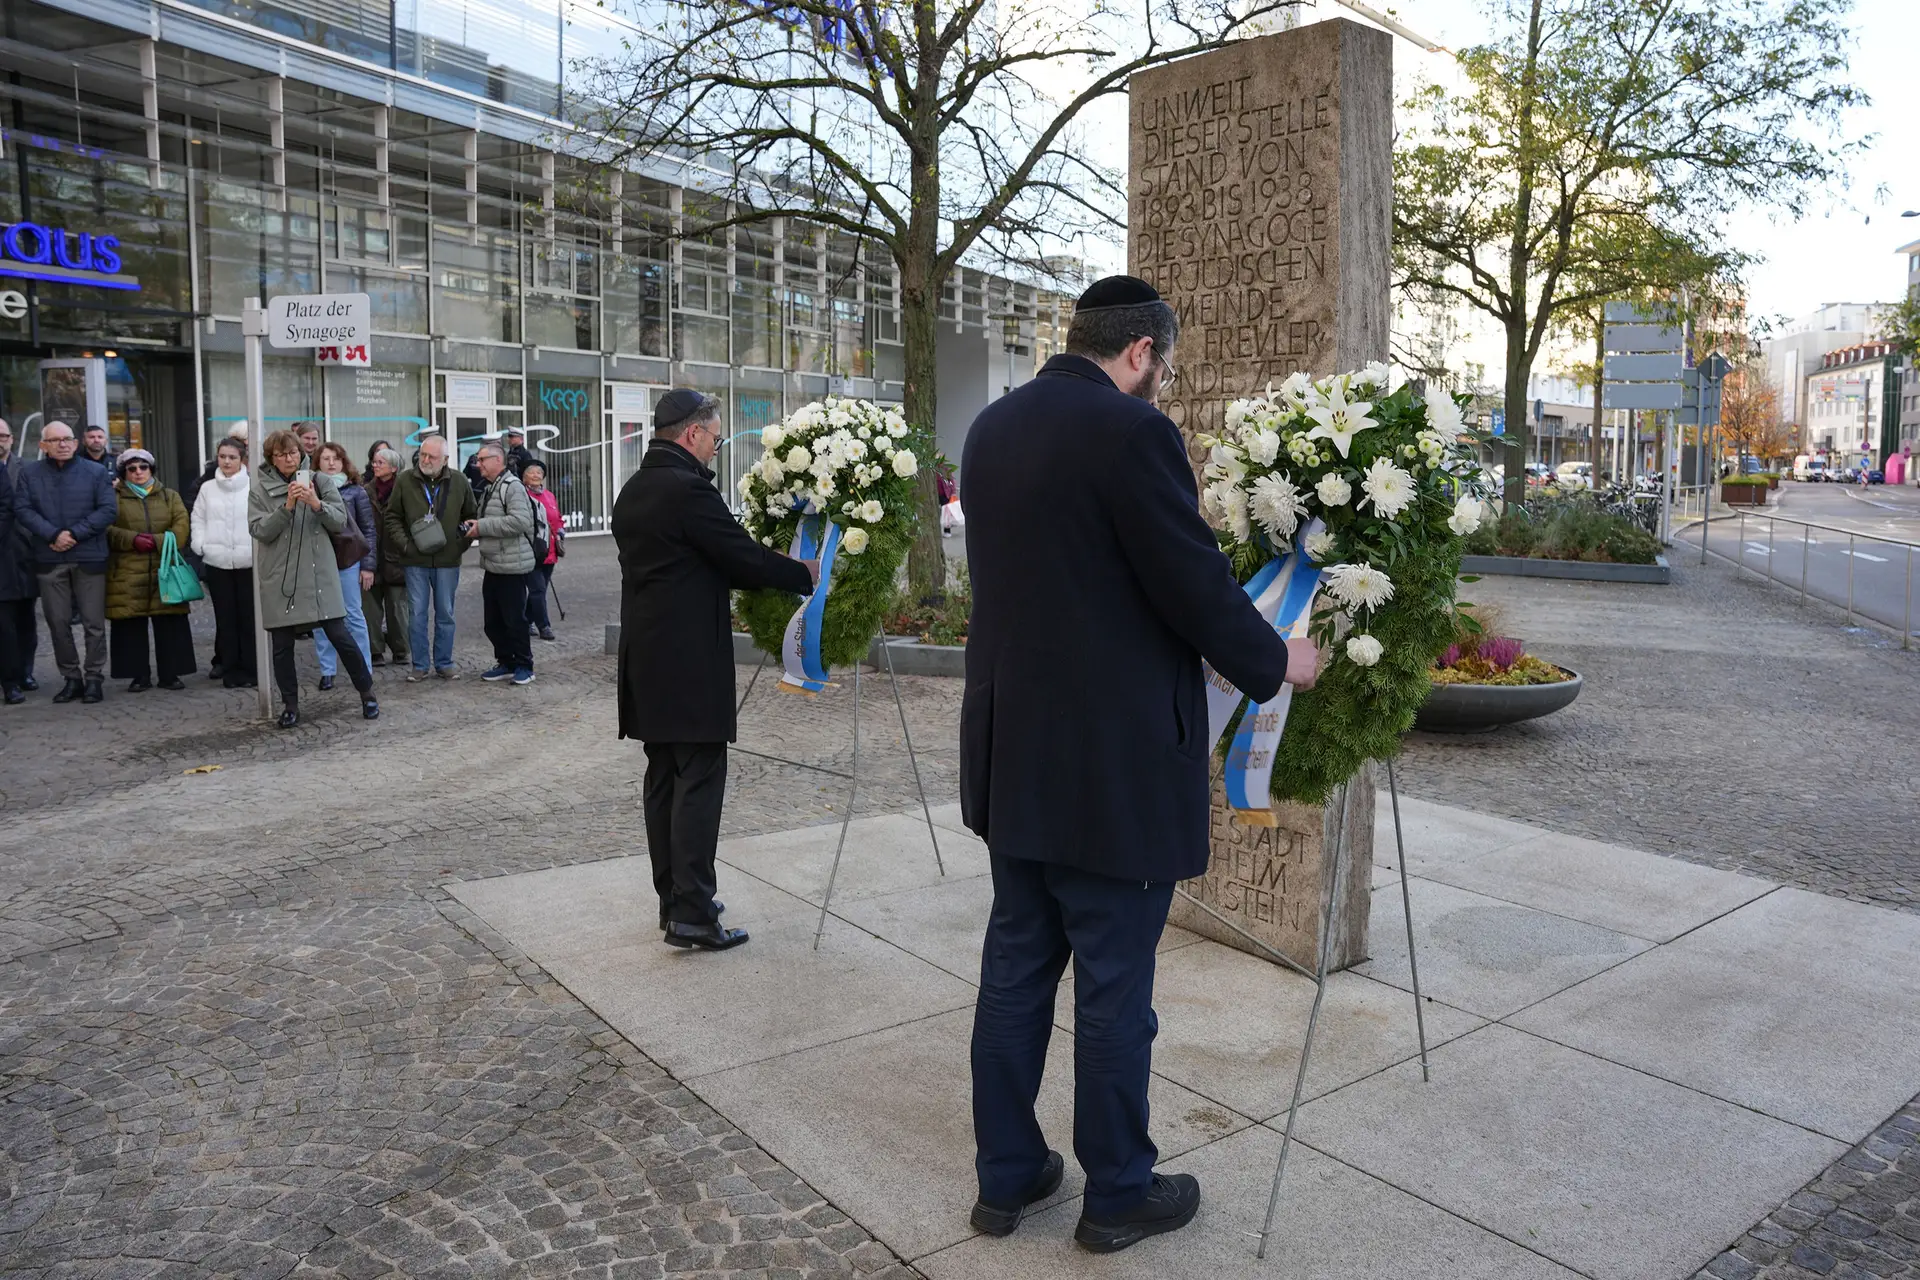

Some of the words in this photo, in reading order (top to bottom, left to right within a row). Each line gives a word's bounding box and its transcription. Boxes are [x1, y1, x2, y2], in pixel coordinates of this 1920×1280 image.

[1140, 76, 1251, 131] UNWEIT
[1144, 117, 1233, 164] DIESER
[1237, 93, 1331, 144] STELLE
[1139, 152, 1228, 197] STAND
[1239, 135, 1306, 179] VON
[1142, 192, 1195, 230] 1893
[1202, 184, 1243, 221] BIS
[1251, 171, 1313, 213] 1938
[0, 222, 122, 274] aus
[1137, 230, 1176, 264] DIE
[1181, 206, 1327, 258] SYNAGOGE
[286, 301, 322, 317] Platz
[326, 300, 352, 316] der
[286, 324, 356, 342] Synagoge
[356, 368, 393, 378] Klimaschutz-
[394, 371, 406, 379] und
[356, 378, 400, 388] Energieagentur
[356, 387, 382, 395] Enzkreis
[540, 379, 588, 417] keep
[356, 396, 387, 404] Pforzheim
[1212, 843, 1287, 893] HEIM
[1225, 881, 1301, 932] STEIN
